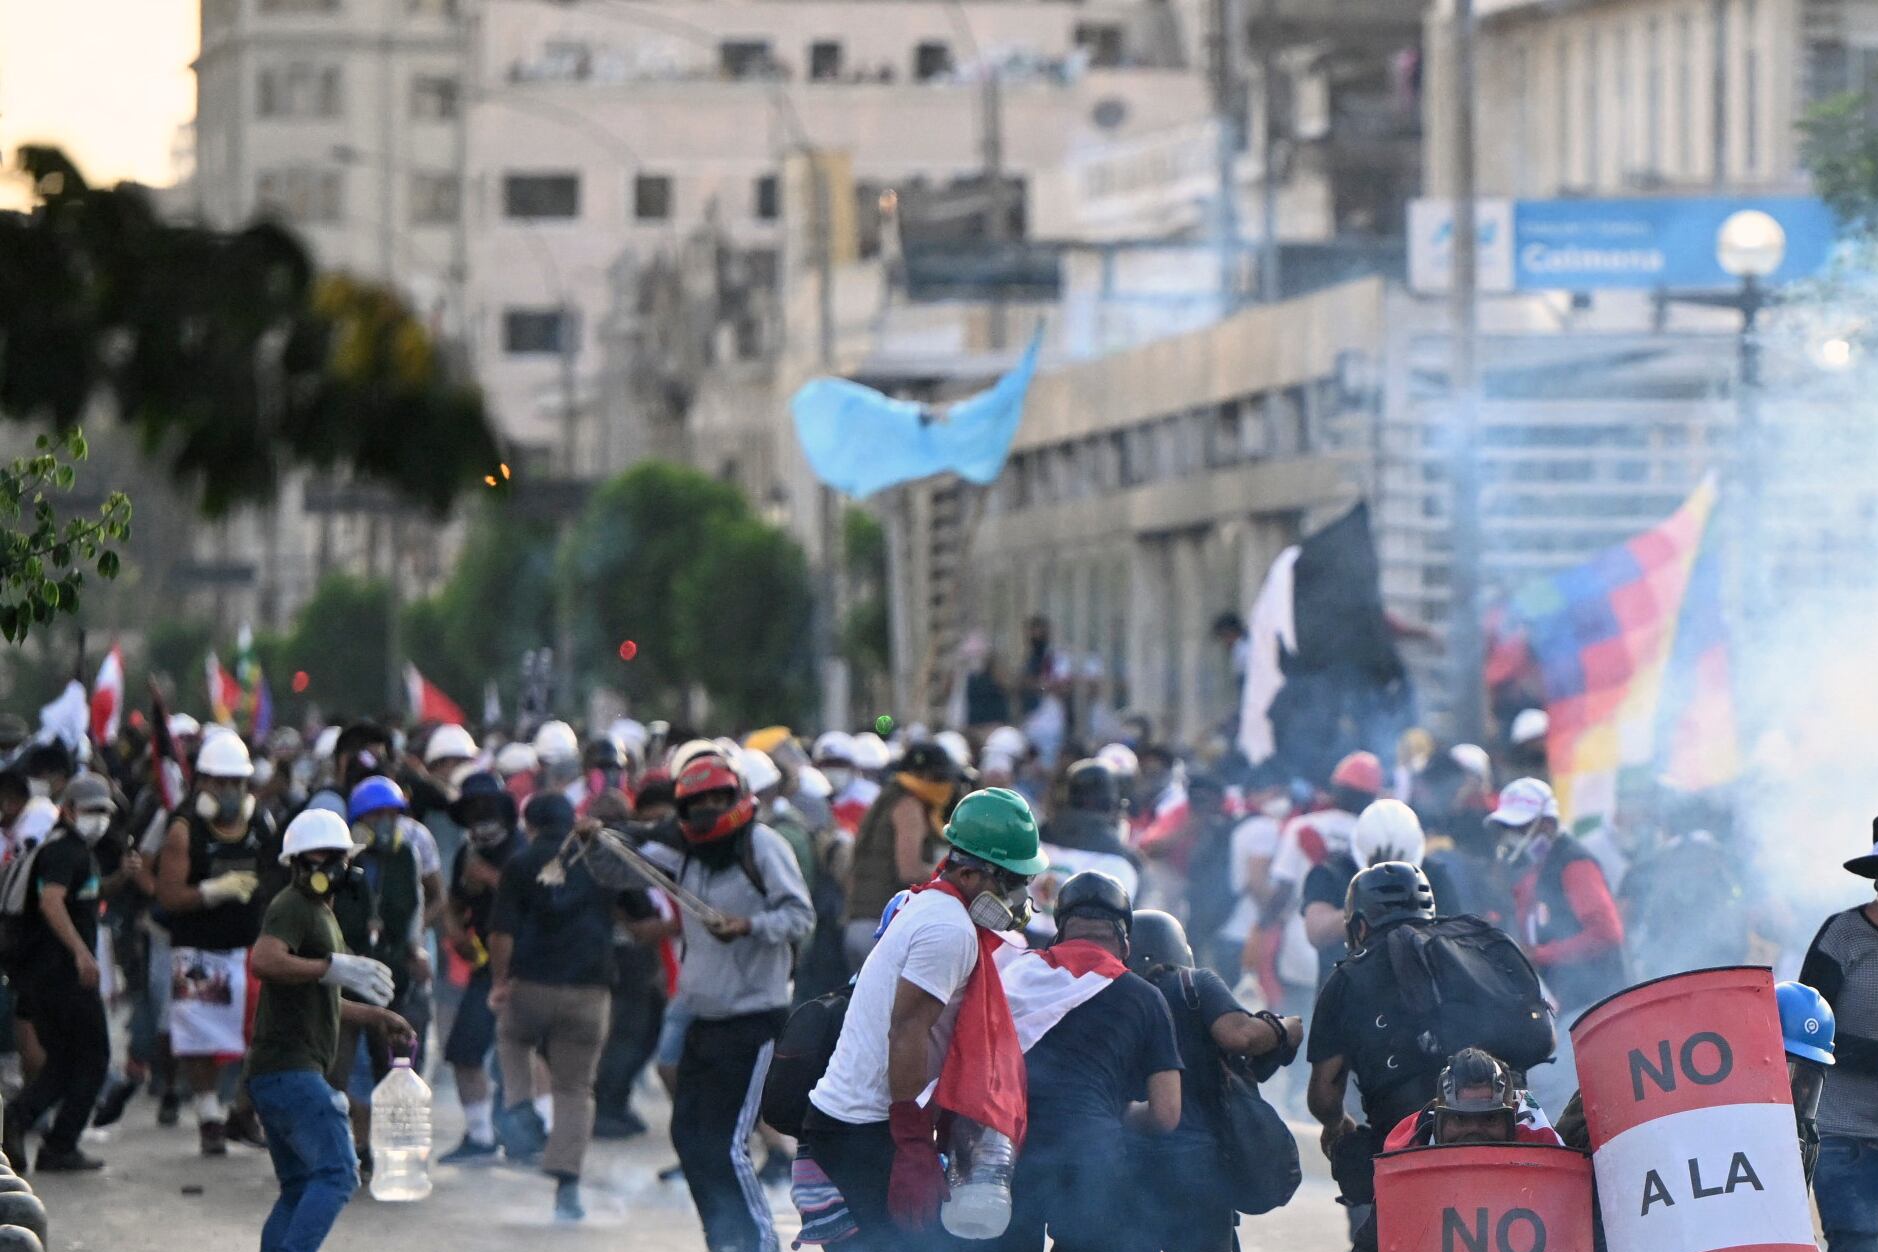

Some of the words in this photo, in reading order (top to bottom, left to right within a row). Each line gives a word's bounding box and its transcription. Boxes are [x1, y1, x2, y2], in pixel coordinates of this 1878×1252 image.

[1627, 1031, 1734, 1102] NO
[1640, 1168, 1676, 1217] A
[1687, 1151, 1765, 1200] LA
